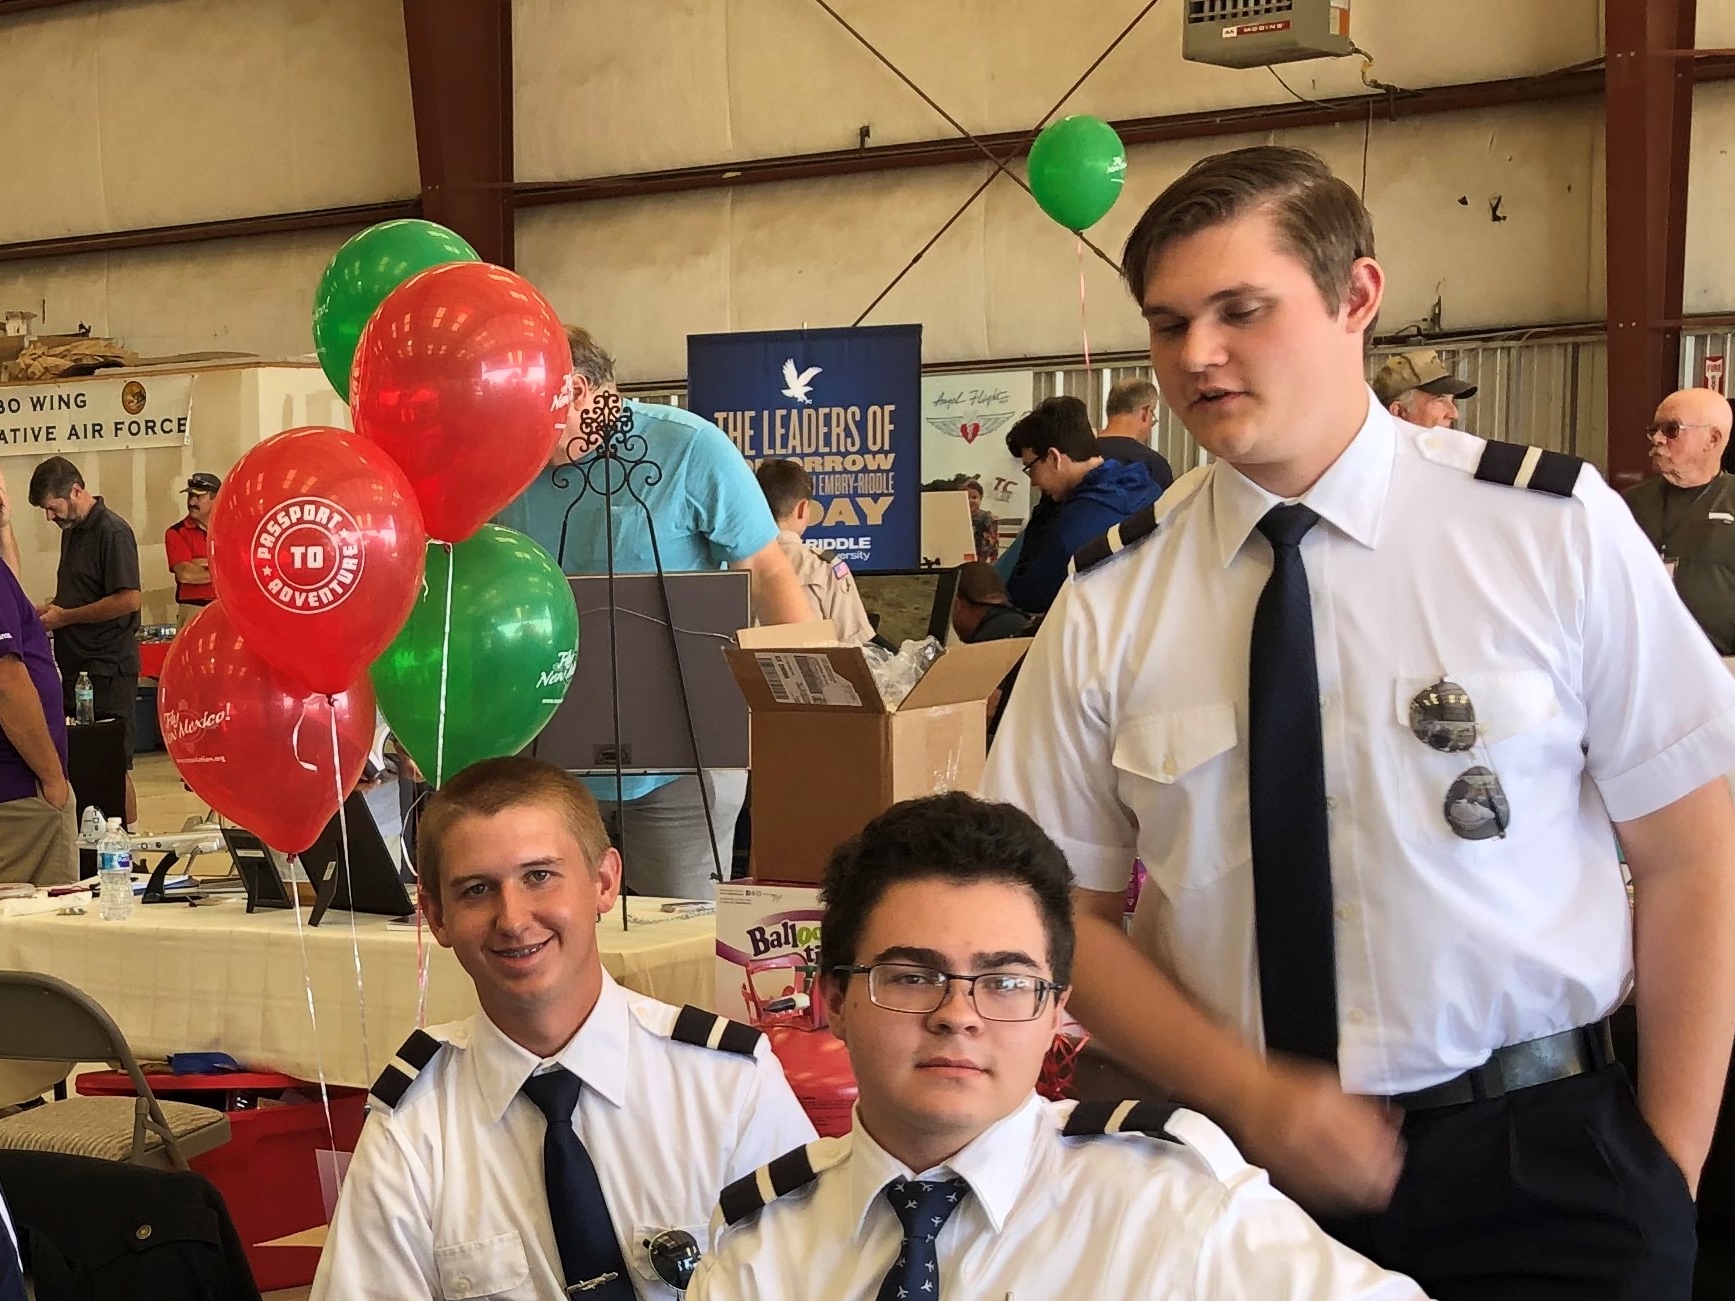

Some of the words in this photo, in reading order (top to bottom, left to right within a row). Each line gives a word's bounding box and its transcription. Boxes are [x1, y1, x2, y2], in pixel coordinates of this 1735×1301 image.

[29, 392, 88, 411] WING
[67, 422, 104, 441] AIR
[114, 416, 188, 438] FORCE
[714, 410, 756, 456] THE
[763, 405, 861, 455] LEADERS
[867, 404, 896, 451] OF
[818, 472, 895, 496] EMBRY-RIDDLE
[803, 496, 895, 527] DAY
[257, 504, 343, 560] PASSPORT
[290, 545, 324, 569] TO
[267, 544, 359, 607] ADVENTURE
[746, 920, 822, 958] Balloo
